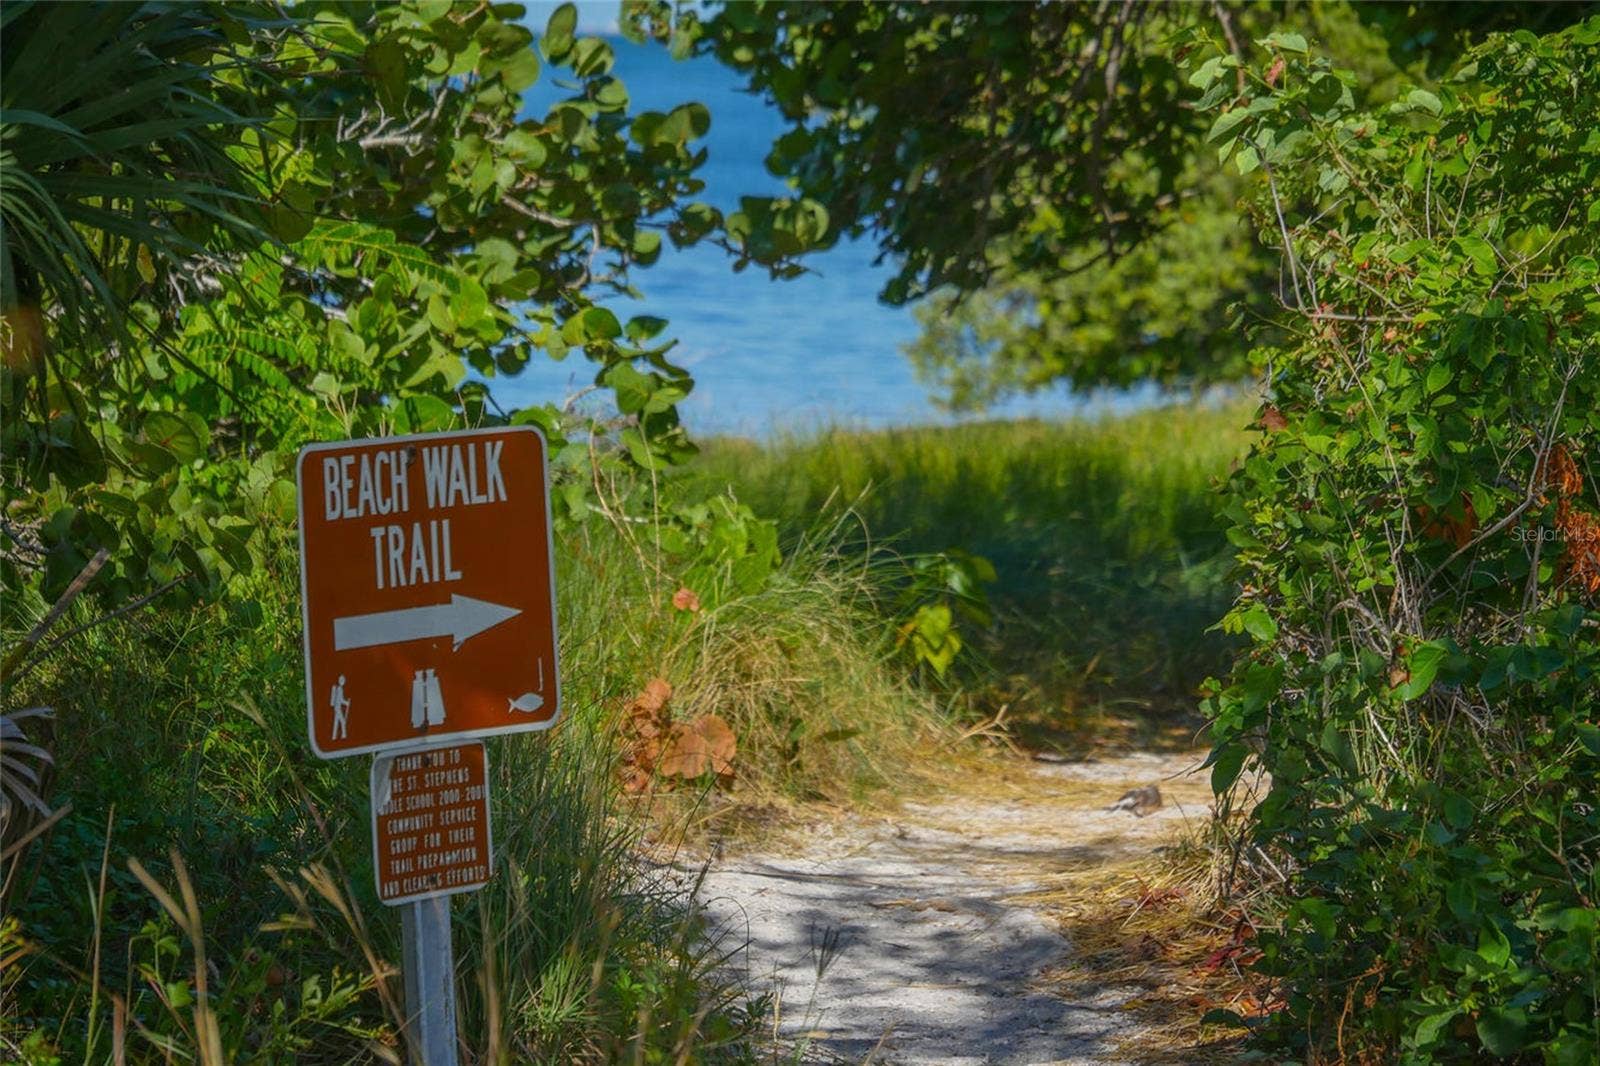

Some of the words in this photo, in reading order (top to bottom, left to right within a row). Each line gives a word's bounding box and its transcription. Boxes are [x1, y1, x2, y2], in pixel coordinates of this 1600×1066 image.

[323, 450, 409, 521] BEACH
[422, 441, 507, 509] WALK
[371, 519, 463, 590] TRAIL
[396, 754, 421, 772] THANK
[449, 748, 460, 764] TO
[391, 777, 403, 794] HE
[425, 767, 470, 788] STEPHENS
[387, 813, 433, 835] COMMUNITY
[440, 806, 476, 826] SERVICE
[390, 836, 417, 855] GROUP
[424, 832, 441, 849] FOR
[448, 826, 475, 844] THEIR
[391, 857, 414, 875] TRAIL
[417, 847, 477, 870] PREPARATION
[384, 881, 400, 898] AND
[446, 865, 485, 886] EFFORTS
